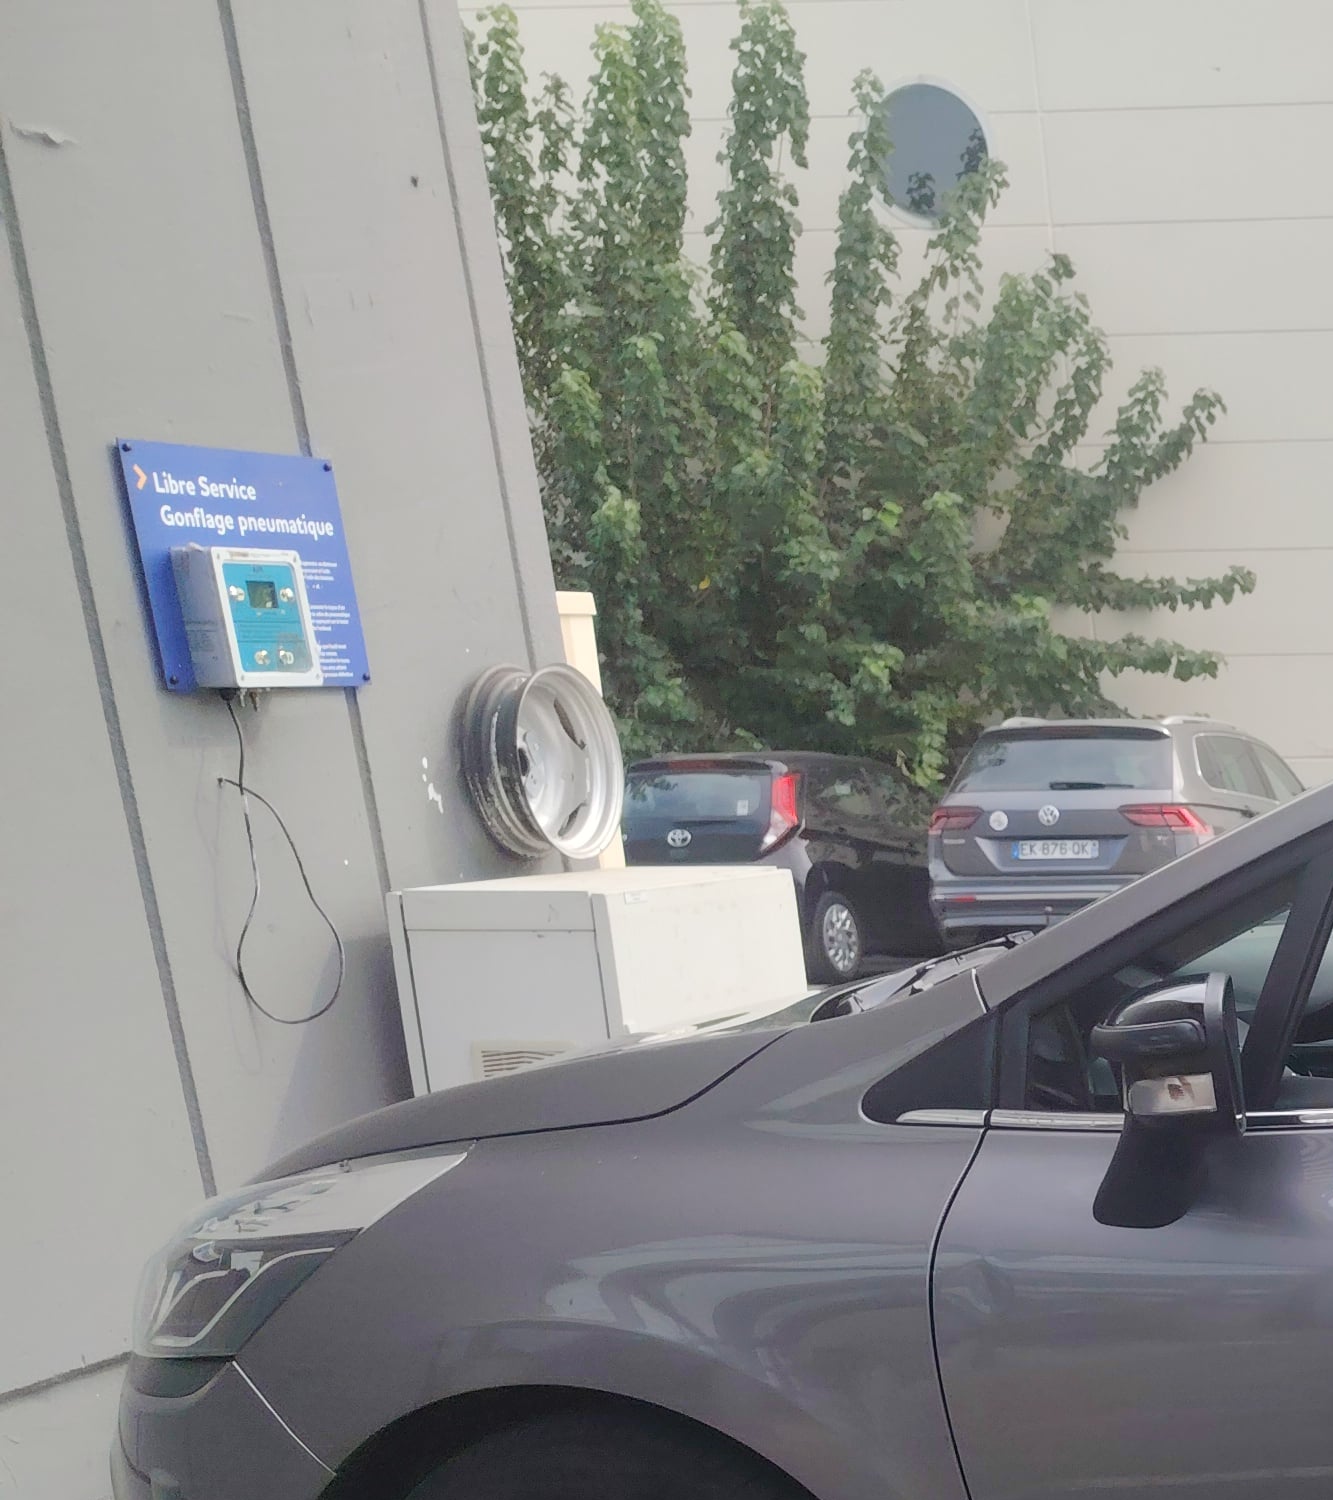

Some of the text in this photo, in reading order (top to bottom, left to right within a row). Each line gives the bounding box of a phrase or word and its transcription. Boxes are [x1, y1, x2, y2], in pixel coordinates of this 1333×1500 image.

[152, 471, 257, 500] Libre Service
[160, 504, 334, 541] Gonflage pneumatique
